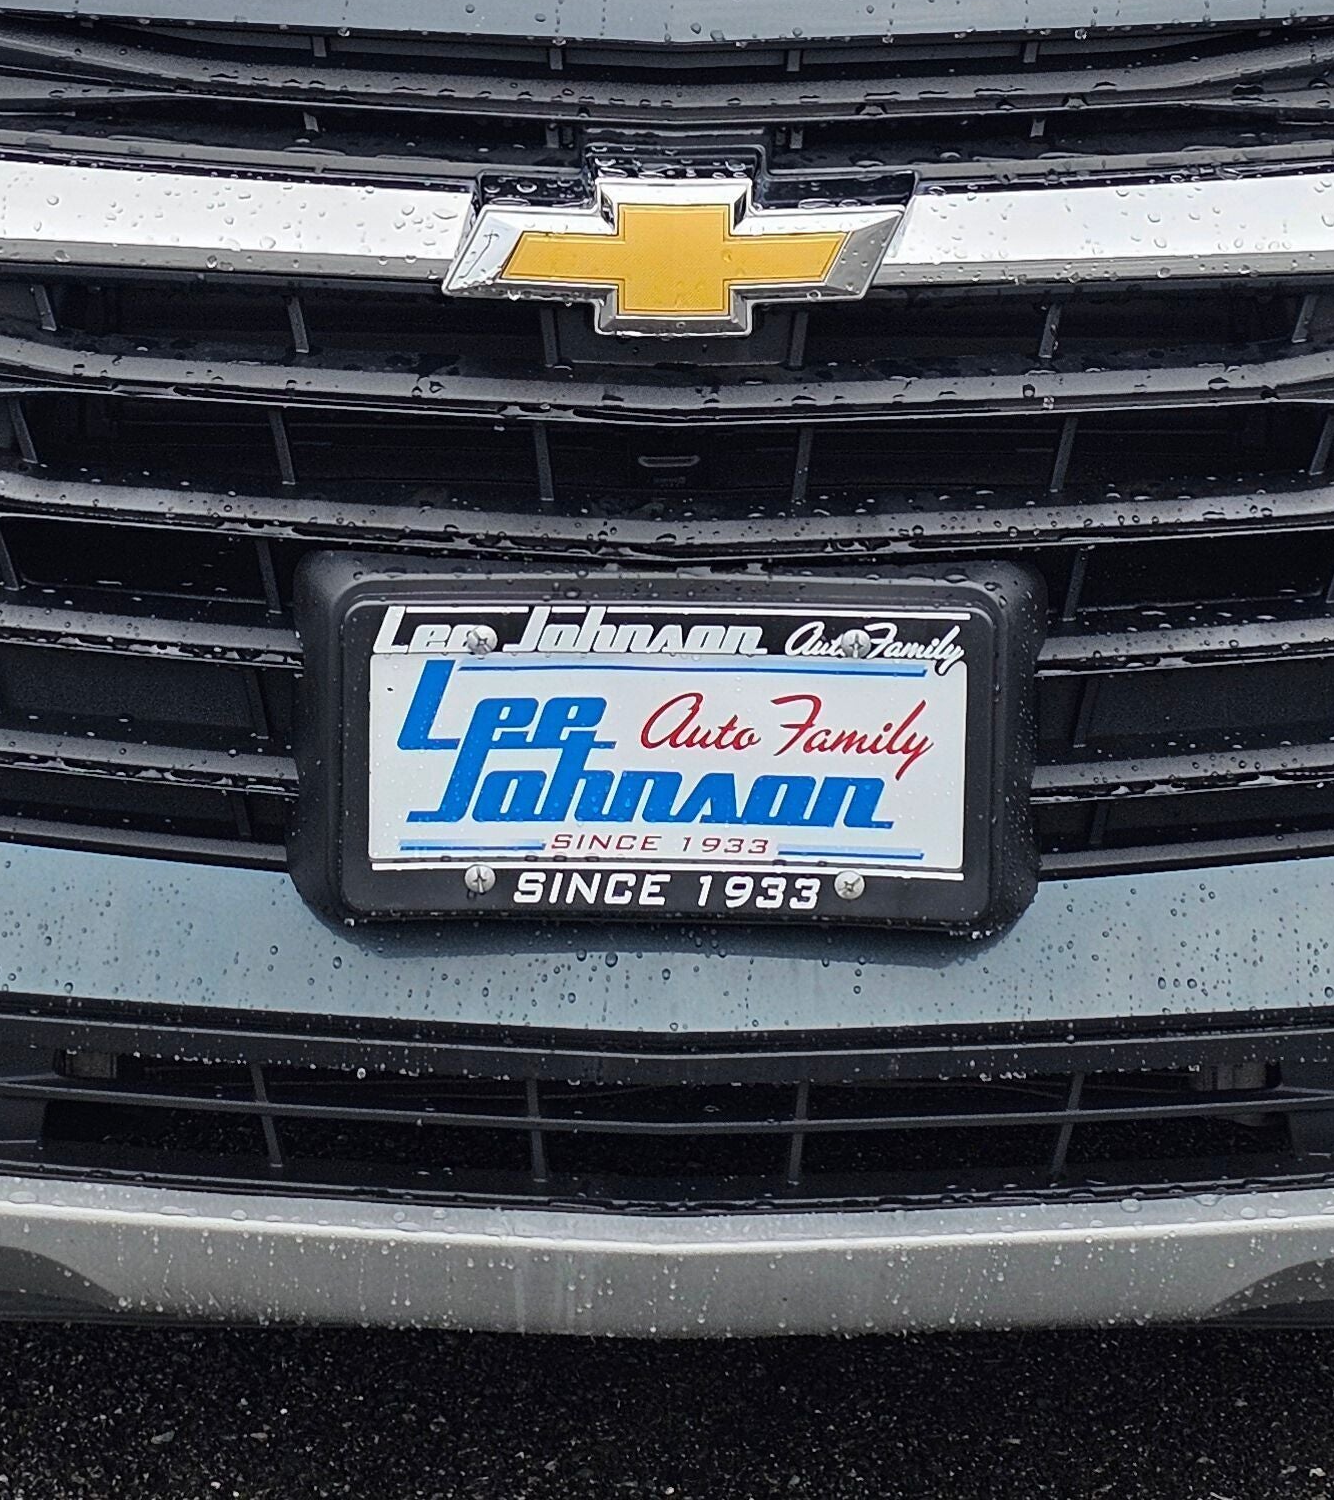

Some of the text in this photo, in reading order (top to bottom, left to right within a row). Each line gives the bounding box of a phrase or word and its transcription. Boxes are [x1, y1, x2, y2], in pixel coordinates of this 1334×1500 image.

[502, 605, 768, 655] Johnson
[865, 621, 965, 675] Family
[396, 659, 616, 751] Lee
[640, 692, 935, 780] Auto Family
[406, 738, 894, 829] Johnson
[551, 834, 769, 854] SINCE 1933
[513, 871, 821, 909] SINCE 1933
